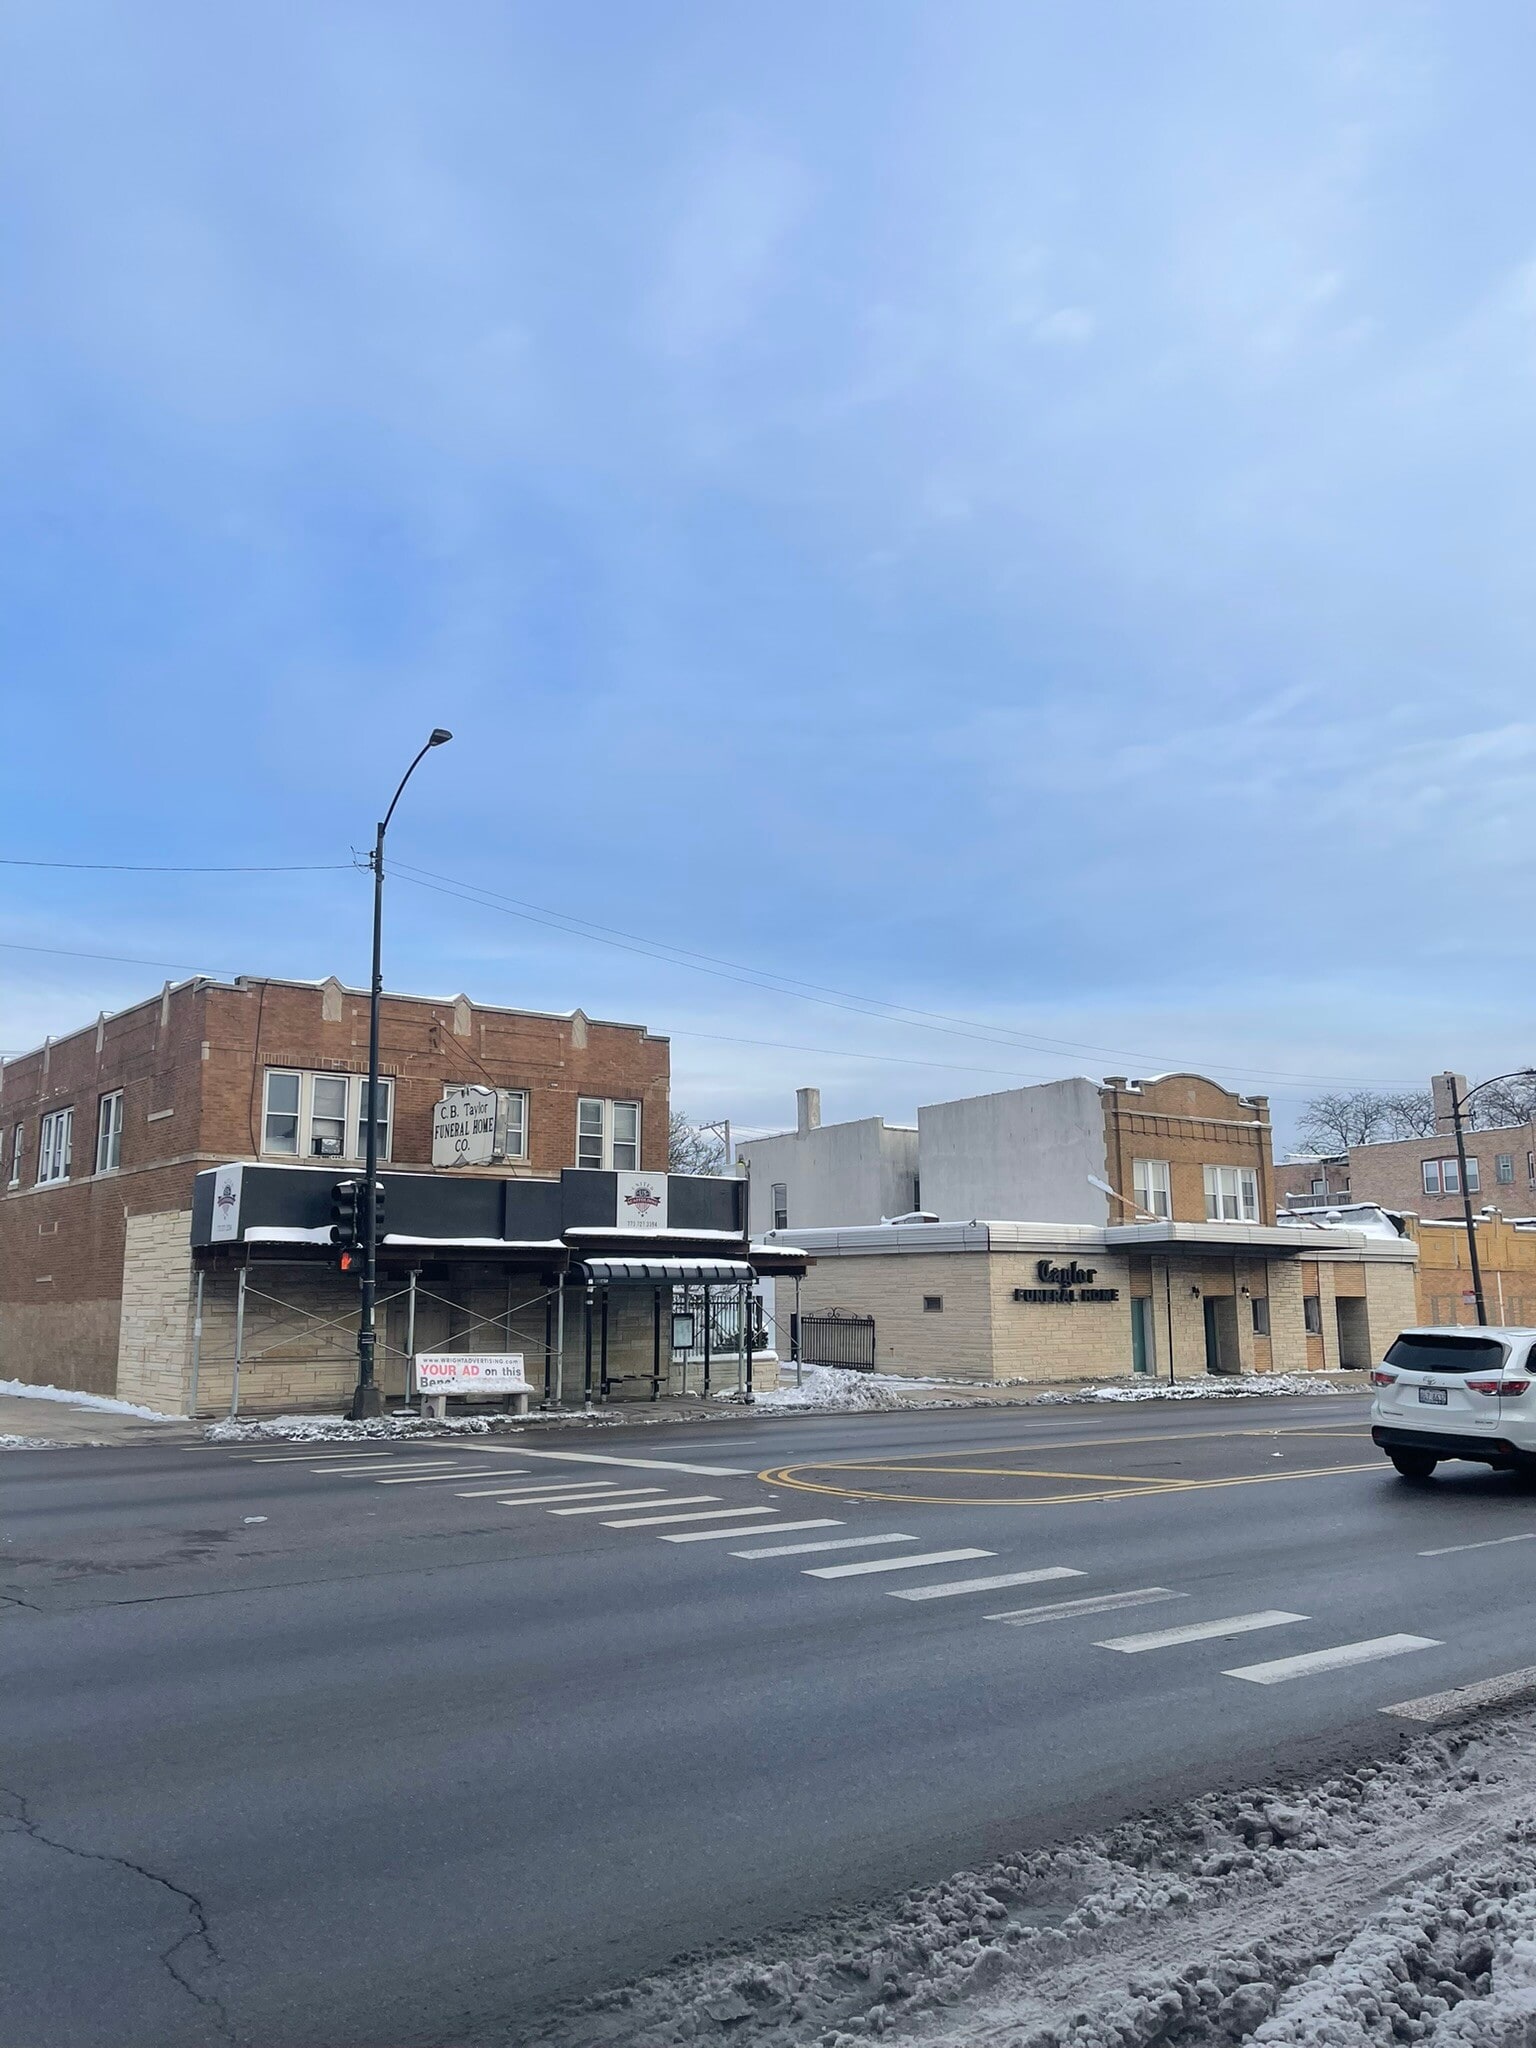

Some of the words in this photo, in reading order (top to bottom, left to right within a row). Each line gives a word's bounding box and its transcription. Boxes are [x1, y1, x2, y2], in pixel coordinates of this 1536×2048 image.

[464, 1101, 488, 1117] Taylor
[434, 1121, 469, 1139] FUNERAL
[472, 1117, 494, 1134] HOME
[454, 1138, 471, 1153] CO.
[1037, 1259, 1098, 1288] Taylor
[1014, 1288, 1078, 1303] FUNERAL
[1081, 1288, 1119, 1301] HOME
[421, 1364, 457, 1376] YOUR
[462, 1365, 480, 1376] AD
[484, 1368, 498, 1377] on
[502, 1366, 522, 1377] this
